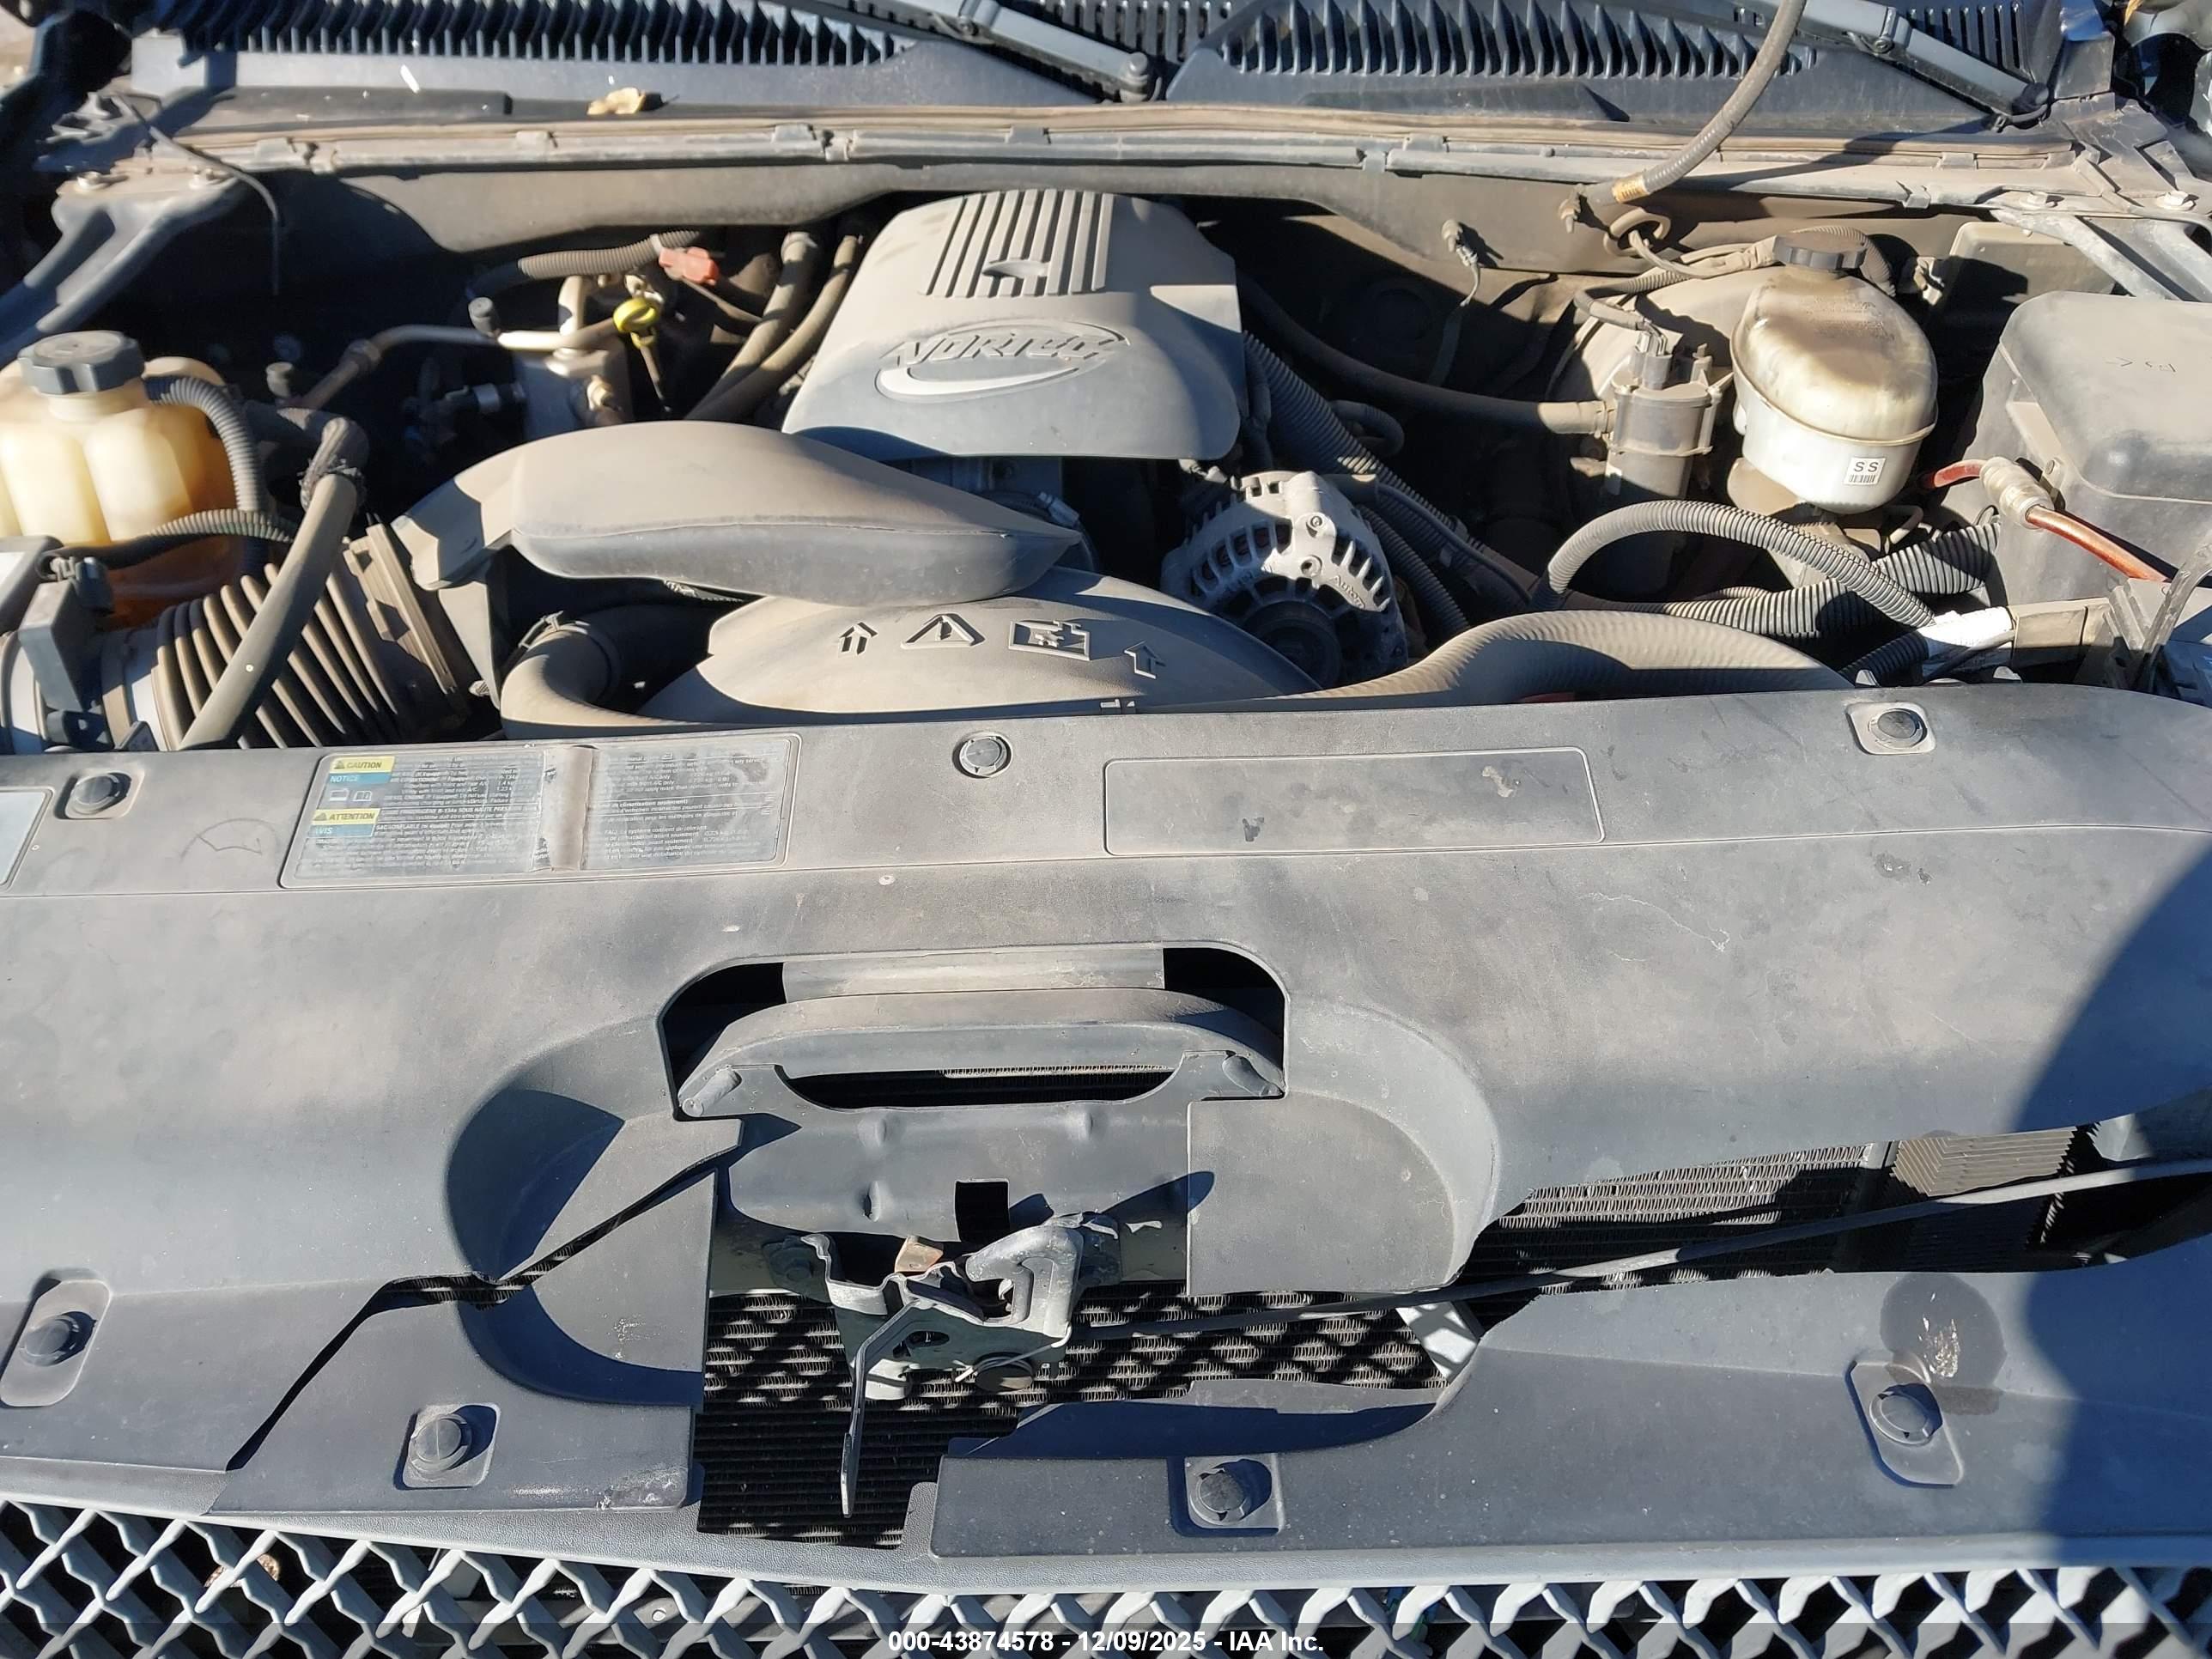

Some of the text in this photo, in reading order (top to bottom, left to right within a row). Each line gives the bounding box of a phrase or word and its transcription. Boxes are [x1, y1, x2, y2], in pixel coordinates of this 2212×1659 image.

[346, 761, 382, 769] CAUTION
[330, 775, 359, 783] NOTICE
[329, 812, 376, 821] ATTENTION
